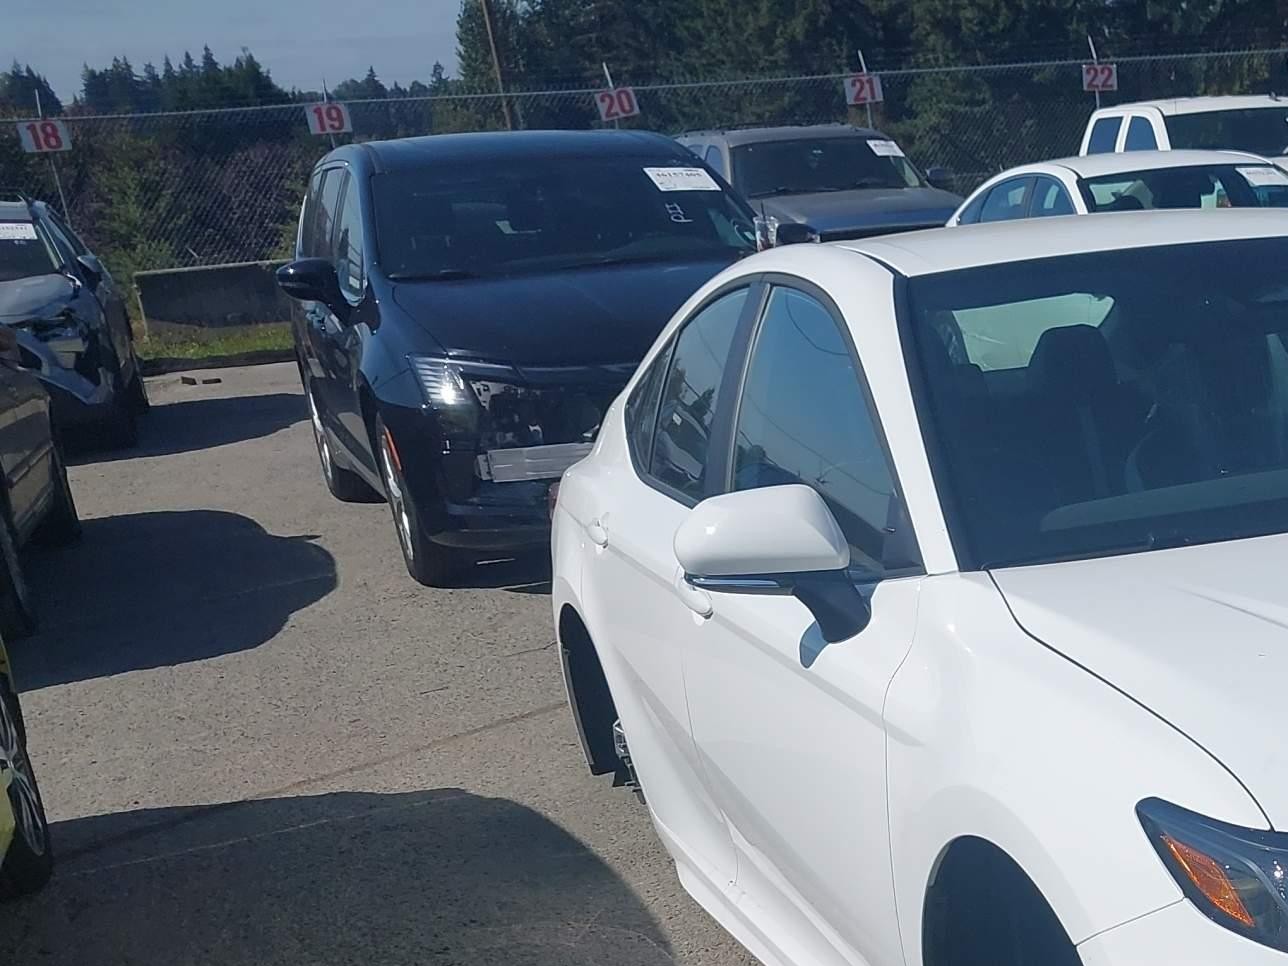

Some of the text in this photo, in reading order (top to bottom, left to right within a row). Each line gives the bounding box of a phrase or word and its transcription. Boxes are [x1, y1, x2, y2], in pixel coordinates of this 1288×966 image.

[851, 77, 877, 103] 21
[1085, 67, 1114, 89] 22
[599, 89, 635, 118] 20
[312, 105, 346, 132] 19
[25, 122, 63, 150] 18
